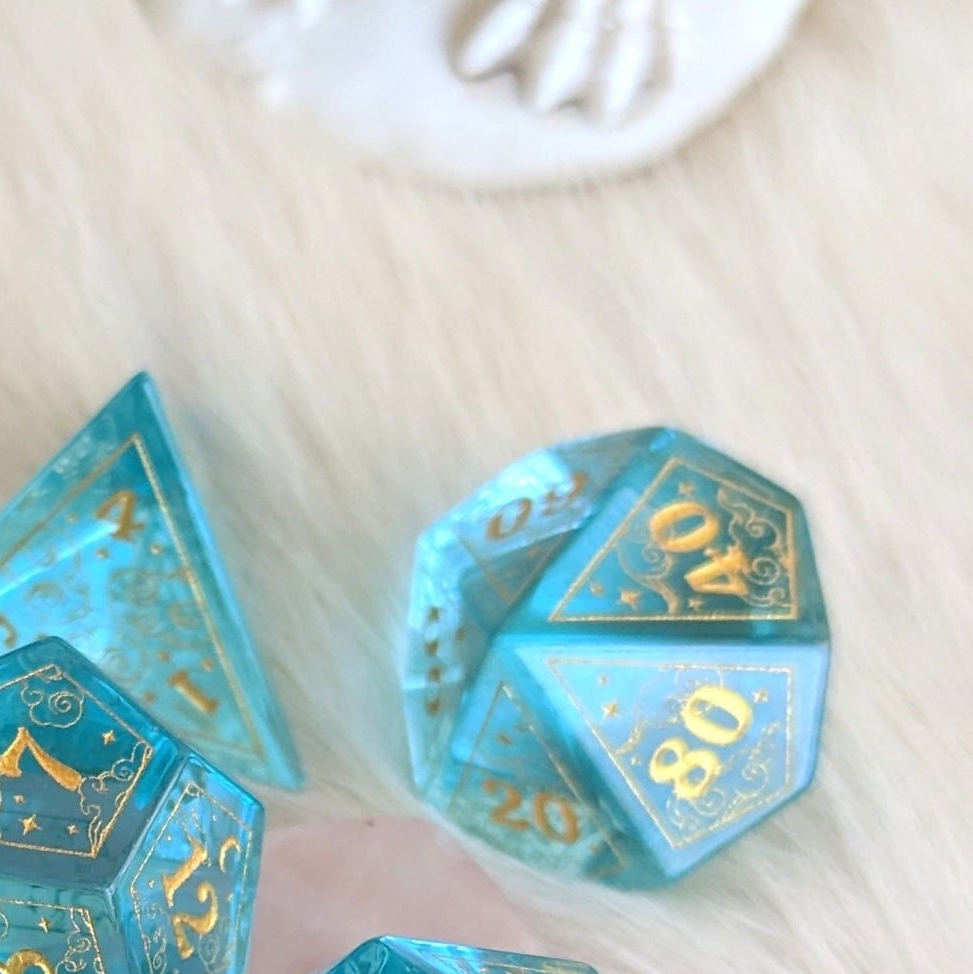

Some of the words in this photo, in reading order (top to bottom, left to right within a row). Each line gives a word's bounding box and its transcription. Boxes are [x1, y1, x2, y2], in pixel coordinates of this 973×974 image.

[96, 490, 144, 541] 4
[649, 501, 753, 597] 40
[649, 685, 753, 799] 80
[483, 779, 581, 844] 20
[162, 839, 219, 960] 12
